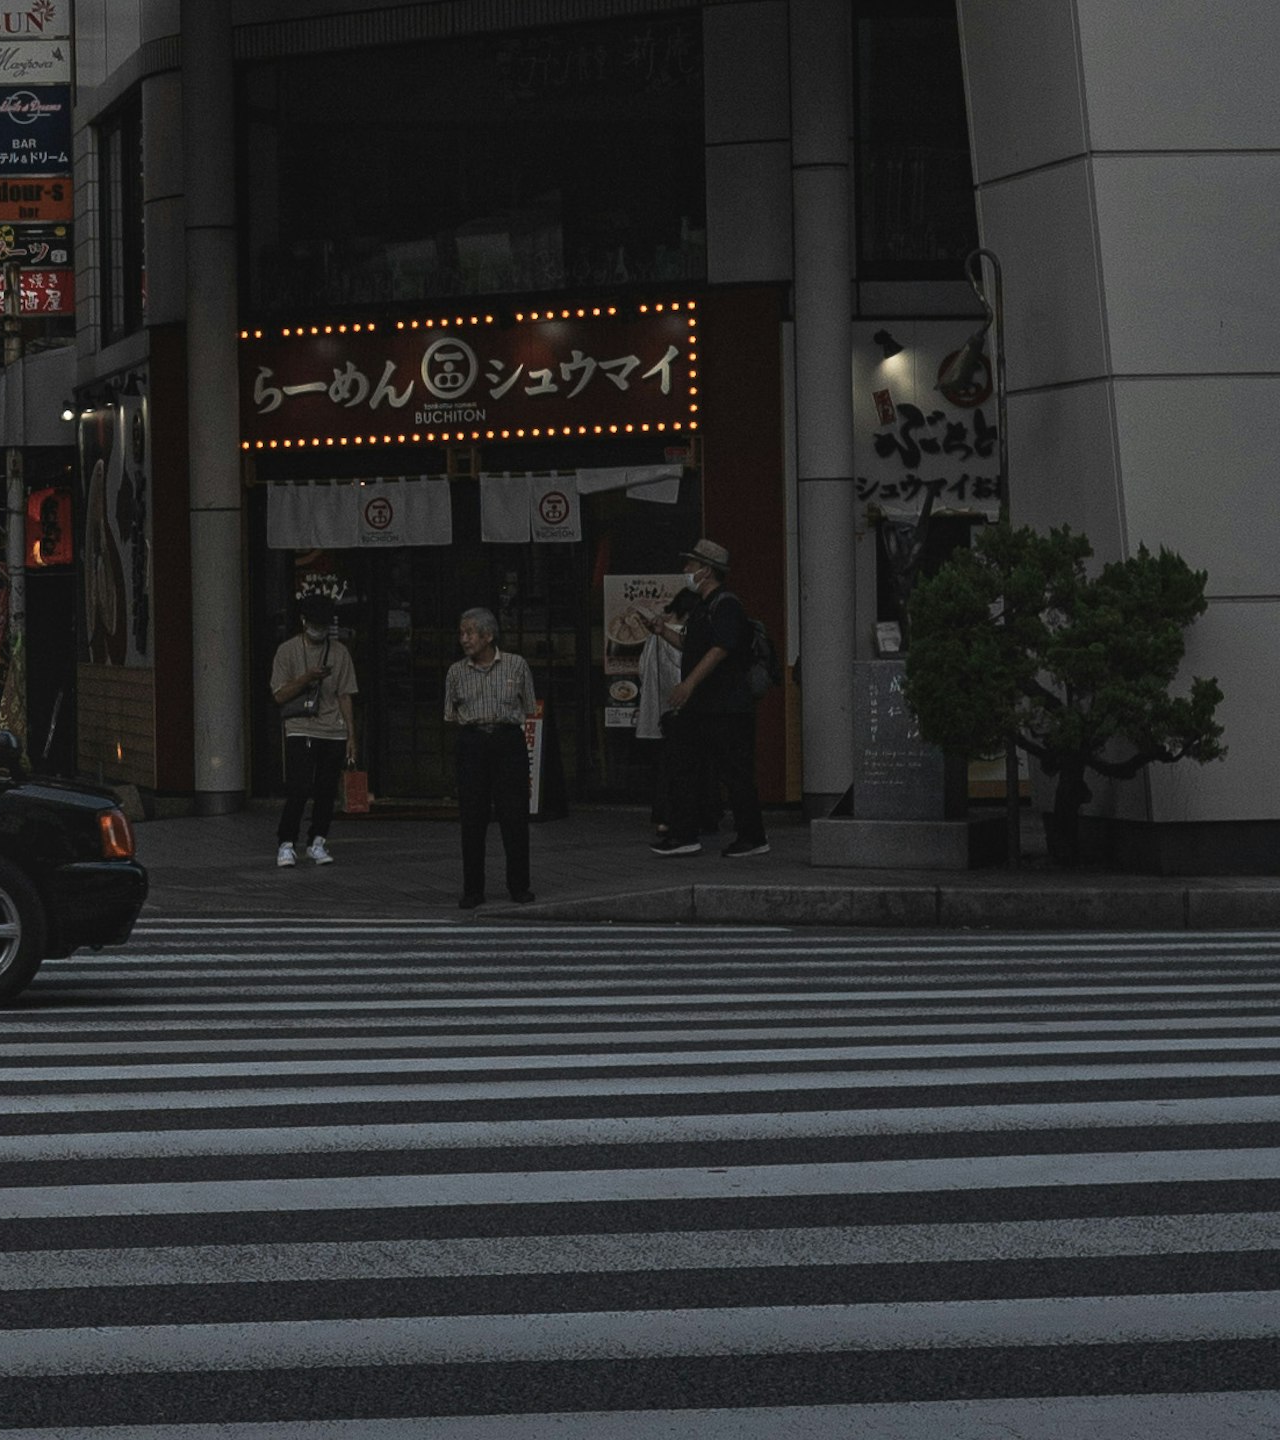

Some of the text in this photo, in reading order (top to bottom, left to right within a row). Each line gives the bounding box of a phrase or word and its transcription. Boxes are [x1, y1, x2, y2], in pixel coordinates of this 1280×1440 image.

[11, 138, 37, 149] BAR
[252, 344, 680, 415] らーめん シュウマイ
[414, 408, 487, 425] BUCHITON
